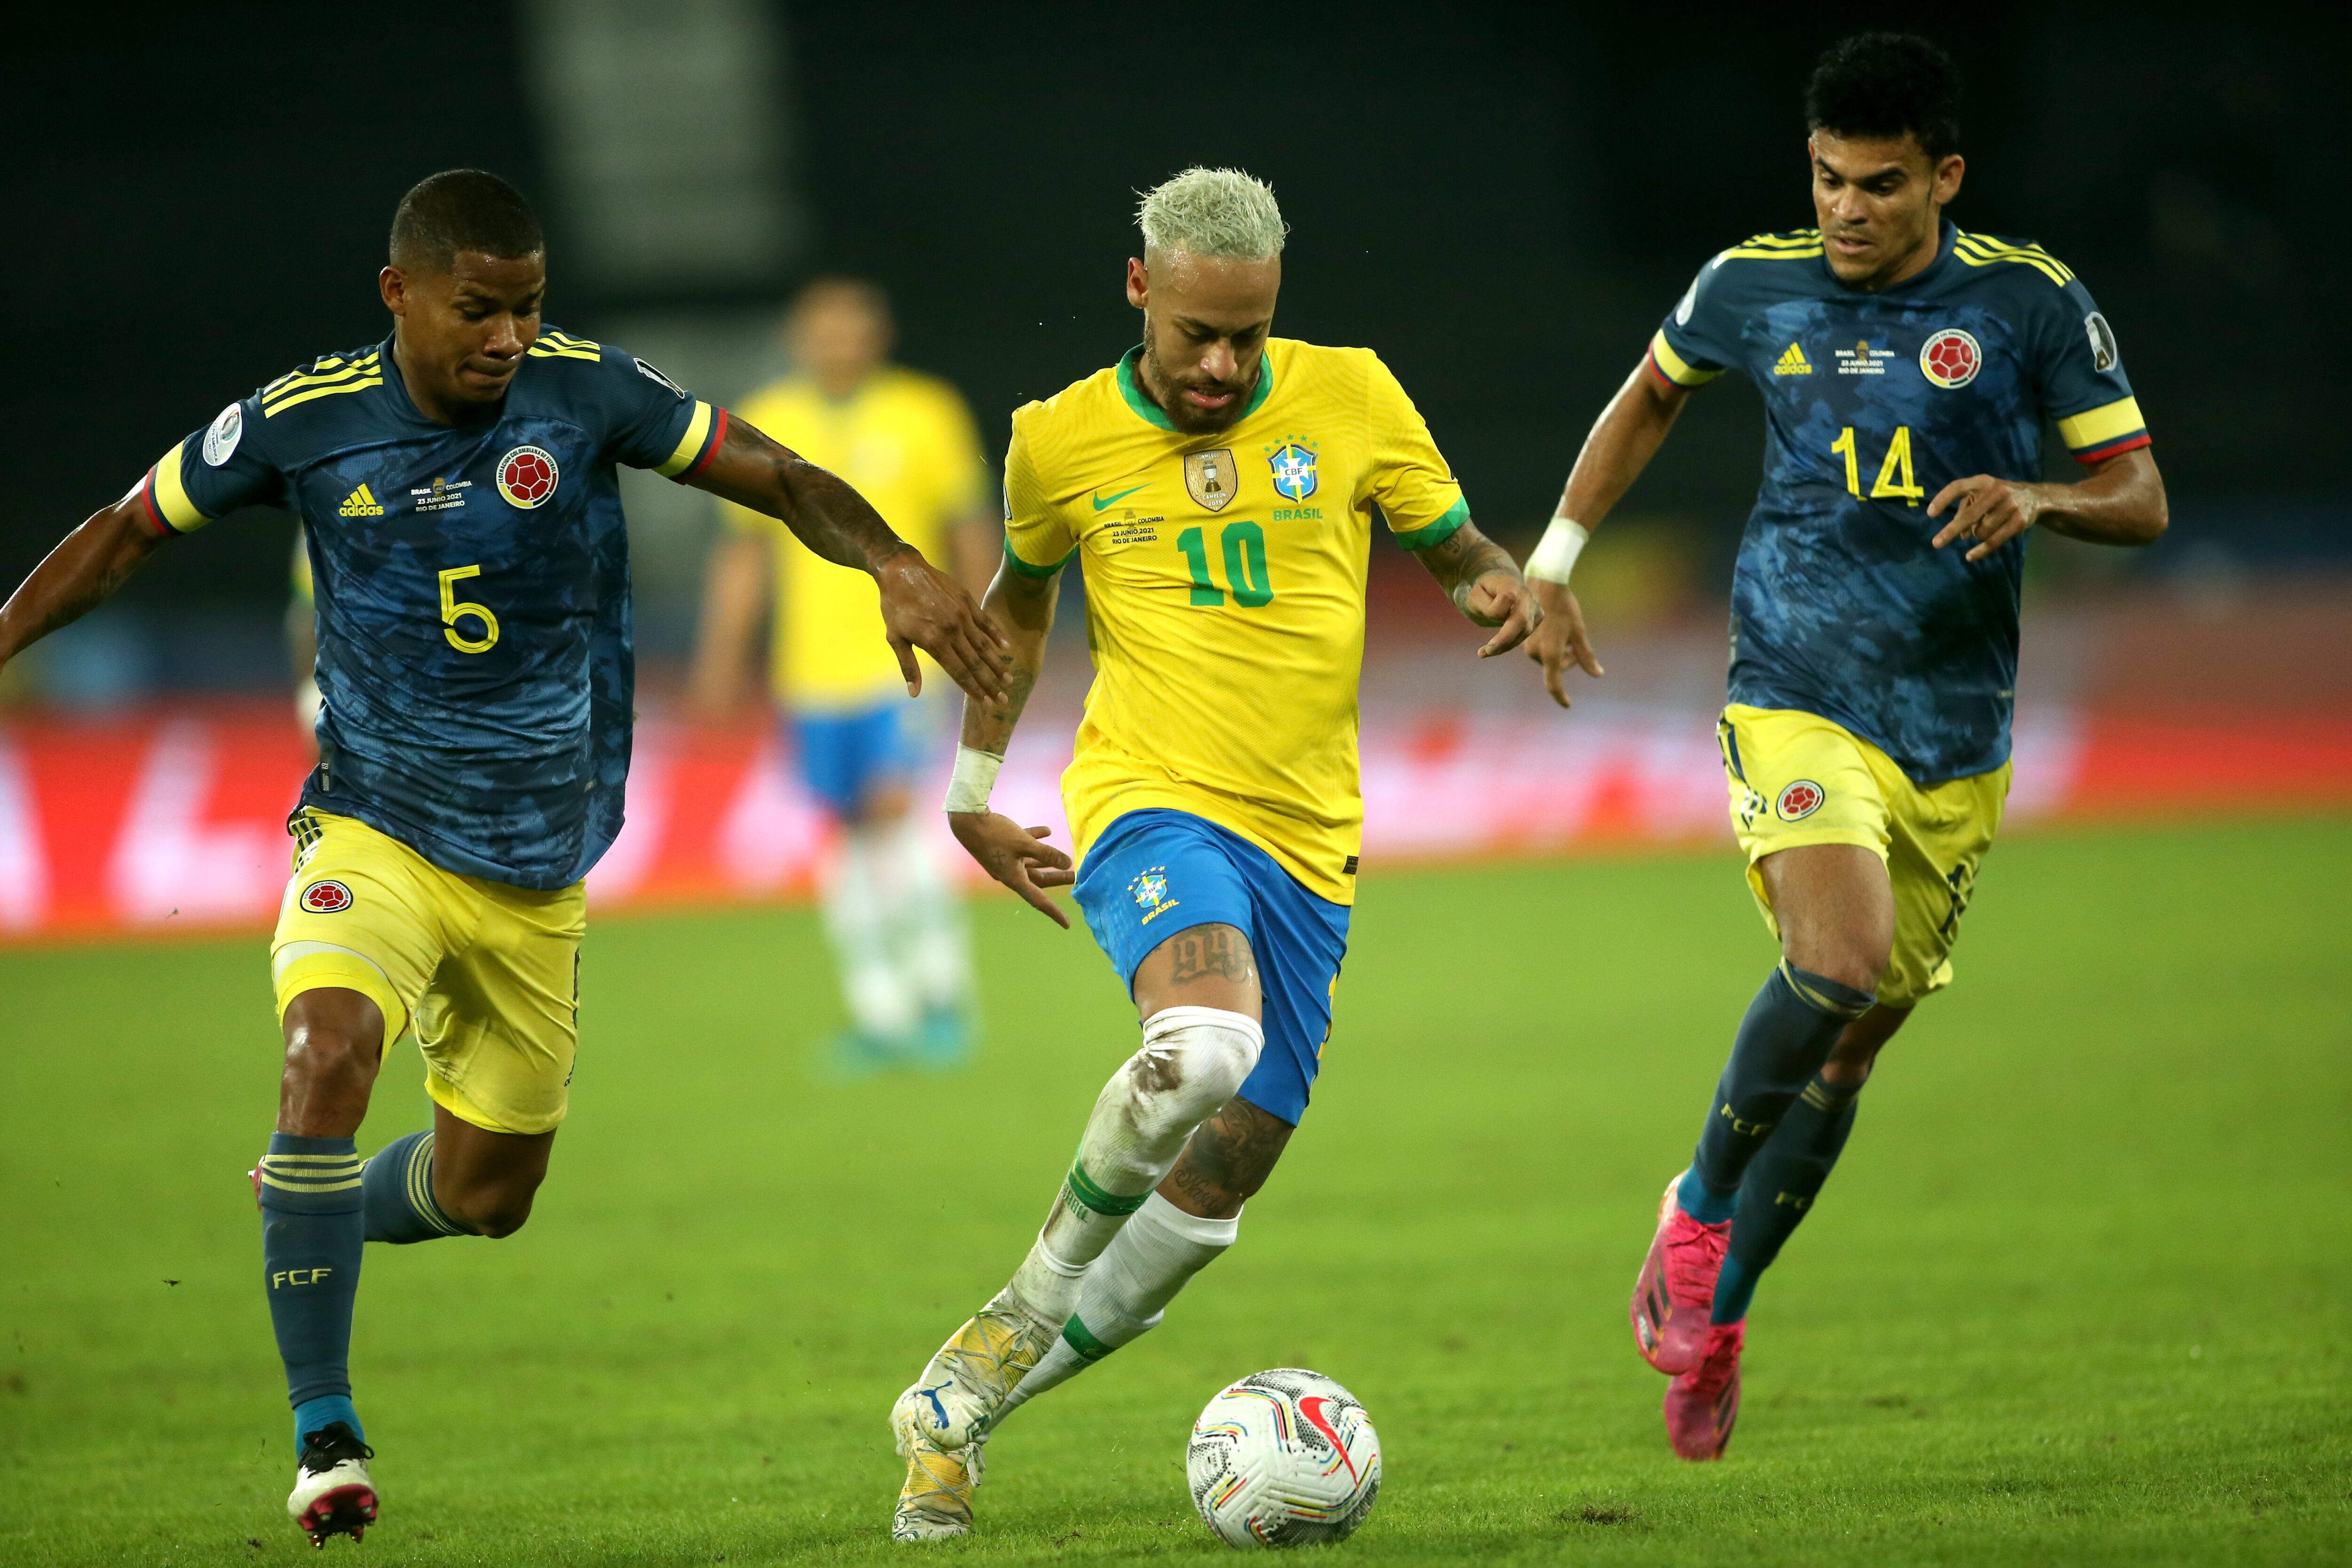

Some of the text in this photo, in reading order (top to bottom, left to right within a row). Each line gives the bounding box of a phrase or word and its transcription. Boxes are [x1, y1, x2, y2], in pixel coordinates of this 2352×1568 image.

[1774, 363, 1812, 375] adidas
[510, 447, 540, 458] COLOMBIANA
[545, 456, 556, 472] FUTBOL
[1831, 426, 1924, 507] 14
[446, 480, 472, 490] COLOMBIA
[339, 504, 384, 517] adidas
[438, 500, 465, 509] JANEIRO
[1138, 516, 1165, 524] COLOMBIA
[1273, 508, 1323, 521] BRASIL
[1176, 520, 1274, 608] 10
[438, 564, 500, 654] 5
[1144, 885, 1157, 896] CBF
[1141, 899, 1180, 926] BRASIL
[1721, 1103, 1772, 1137] FCF
[273, 1268, 332, 1289] FCF
